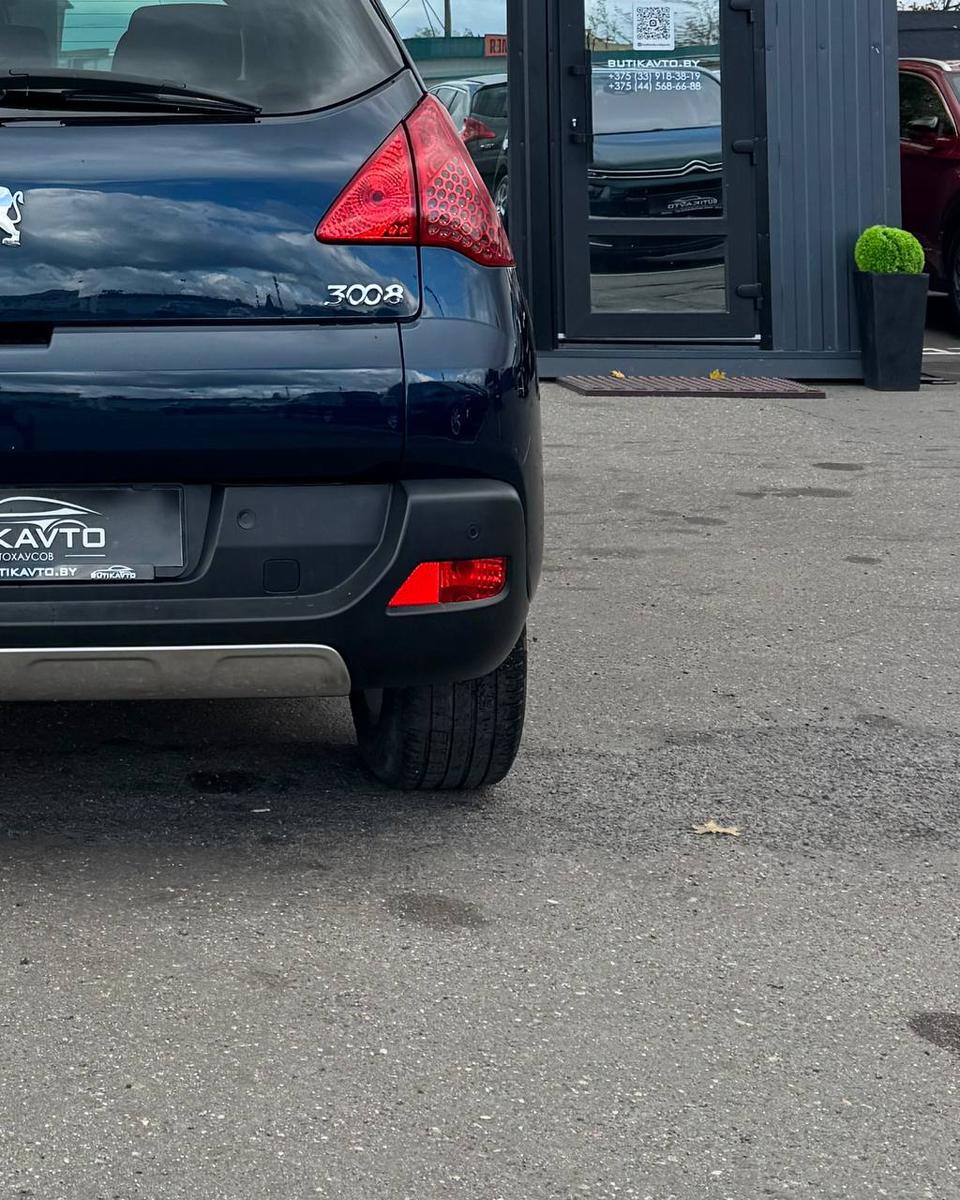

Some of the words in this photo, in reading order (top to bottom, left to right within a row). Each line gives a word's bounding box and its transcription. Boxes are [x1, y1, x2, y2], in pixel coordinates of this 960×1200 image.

[607, 59, 701, 68] BUTIKAVTO.BY
[608, 71, 632, 82] +375
[634, 71, 652, 82] (33)
[654, 71, 701, 82] 918-38-19
[608, 81, 632, 91] +375
[634, 81, 653, 93] (44)
[654, 81, 701, 91] 568-66-88
[324, 283, 404, 306] 3008
